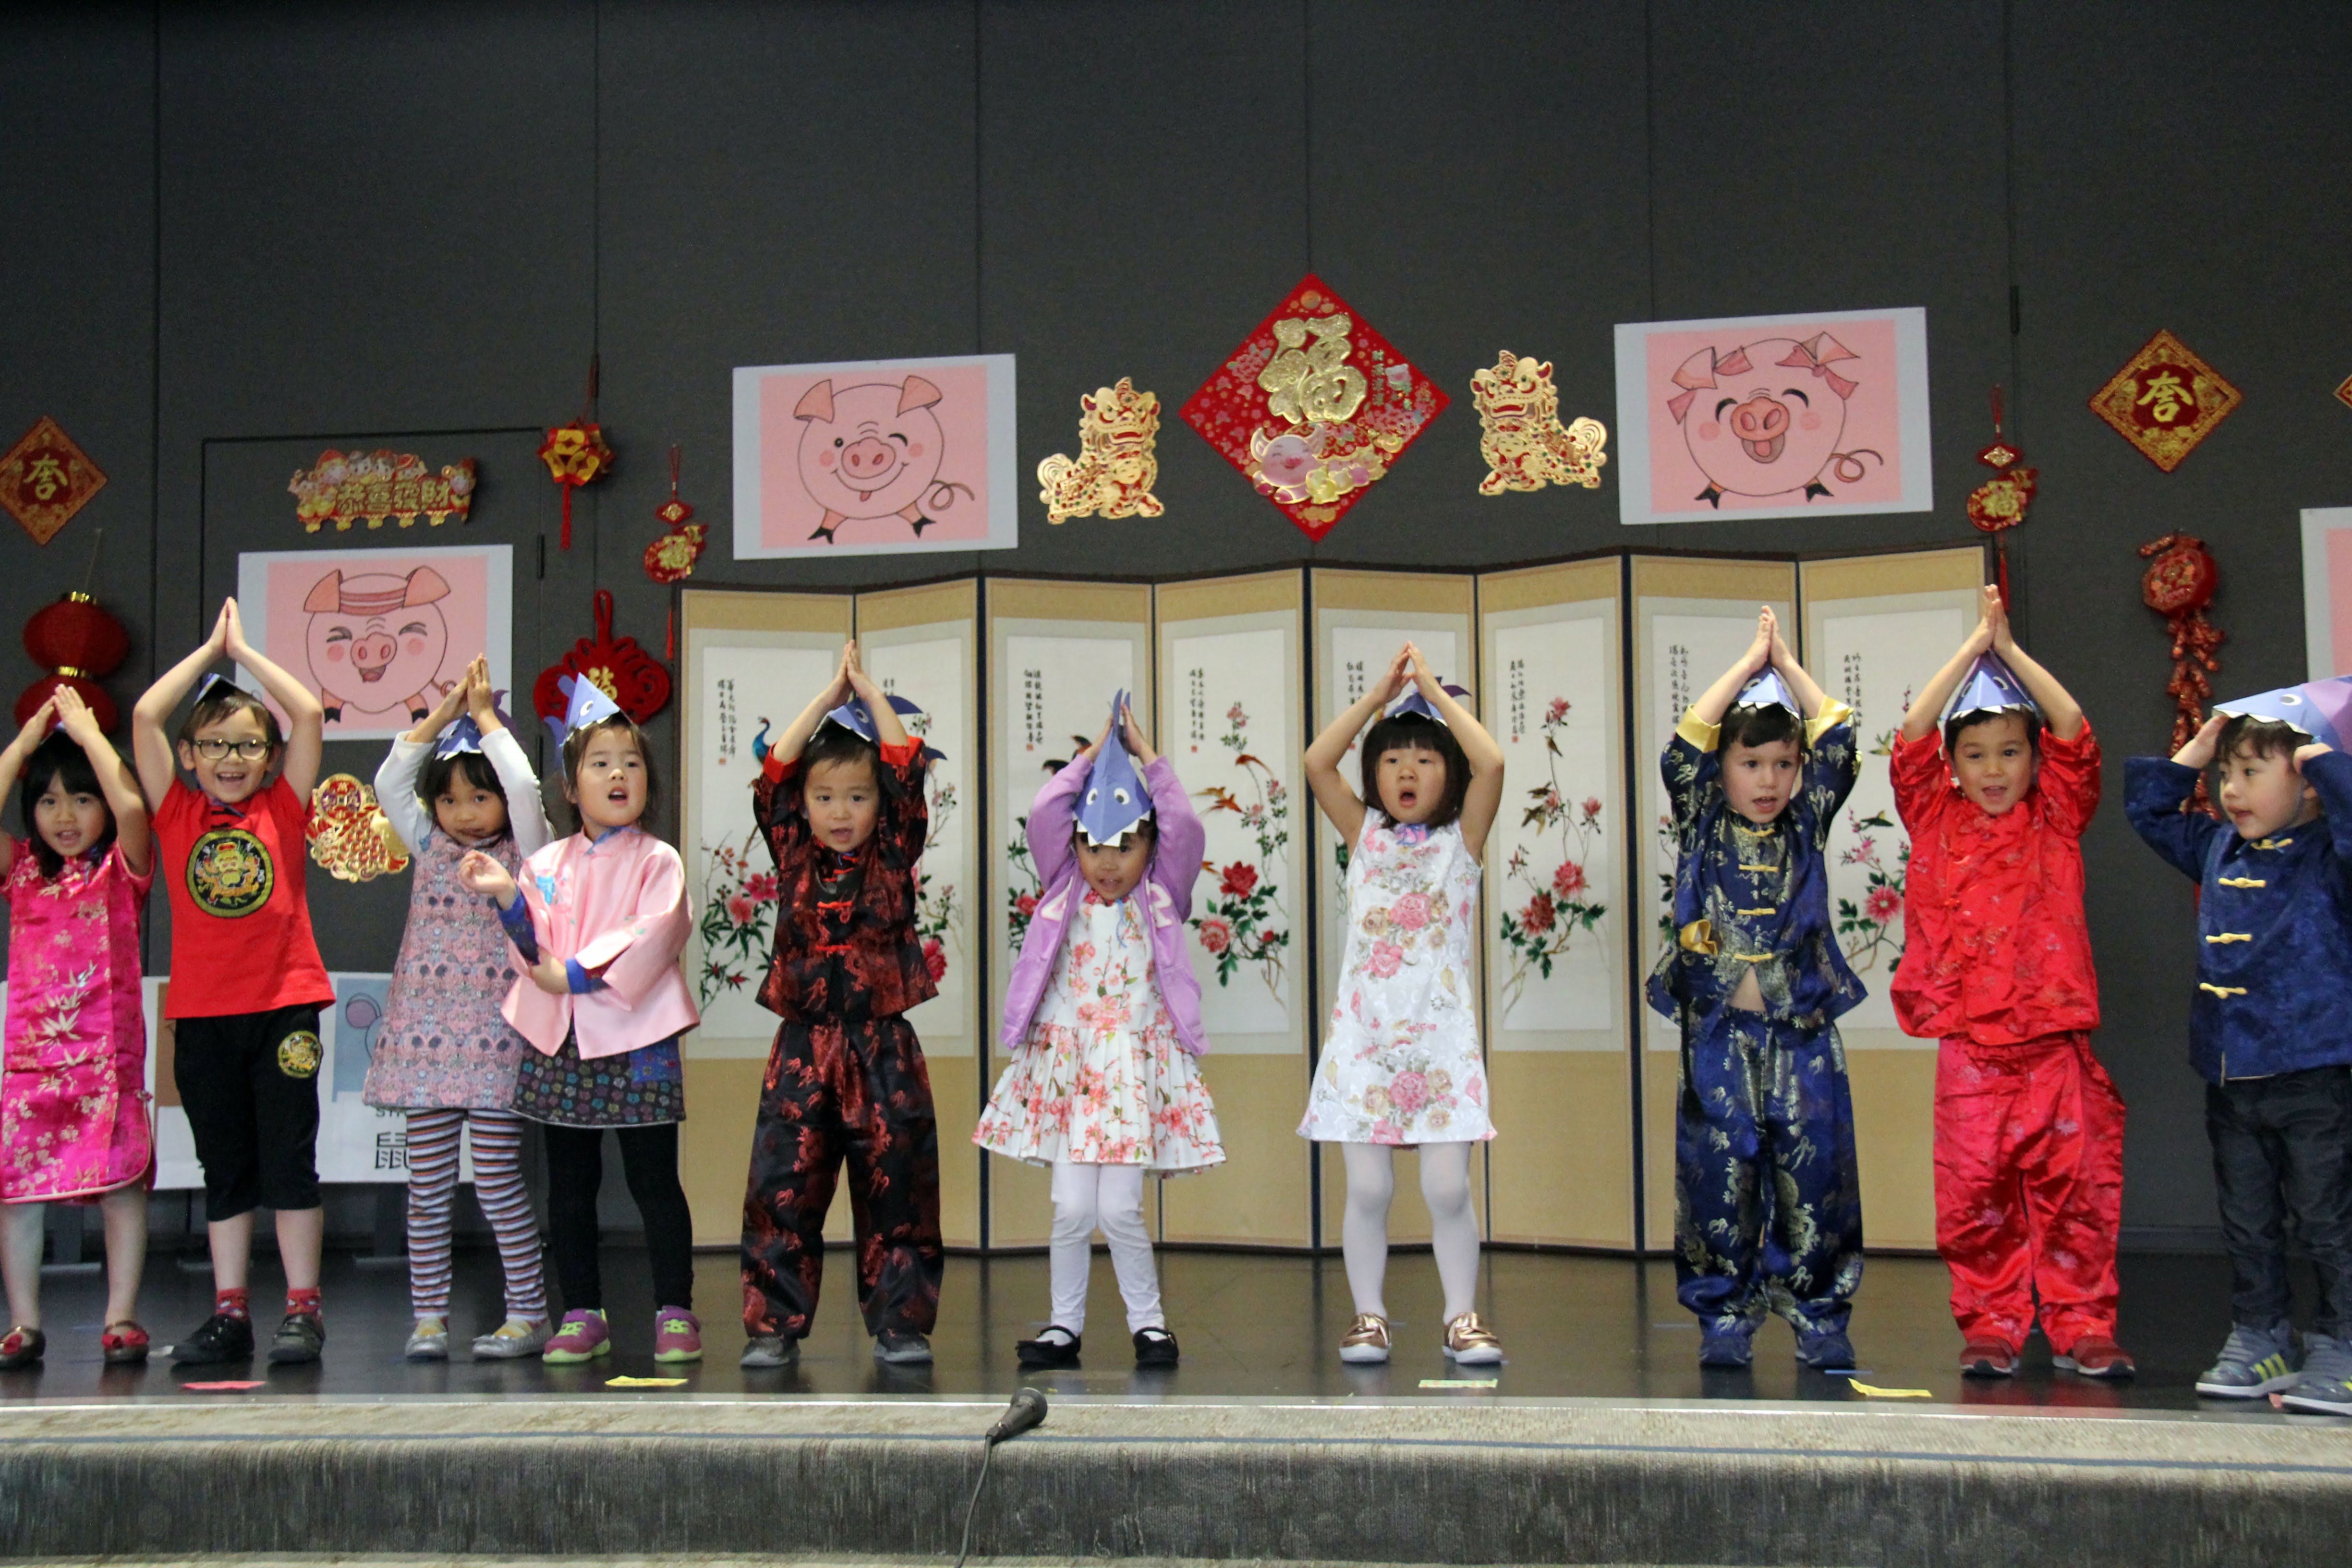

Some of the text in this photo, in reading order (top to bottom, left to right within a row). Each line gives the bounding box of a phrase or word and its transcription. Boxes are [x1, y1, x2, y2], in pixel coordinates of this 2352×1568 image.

[1258, 314, 1367, 424] 福
[2136, 371, 2194, 423] 春
[24, 453, 68, 500] 春
[337, 480, 450, 515] 恭喜發財
